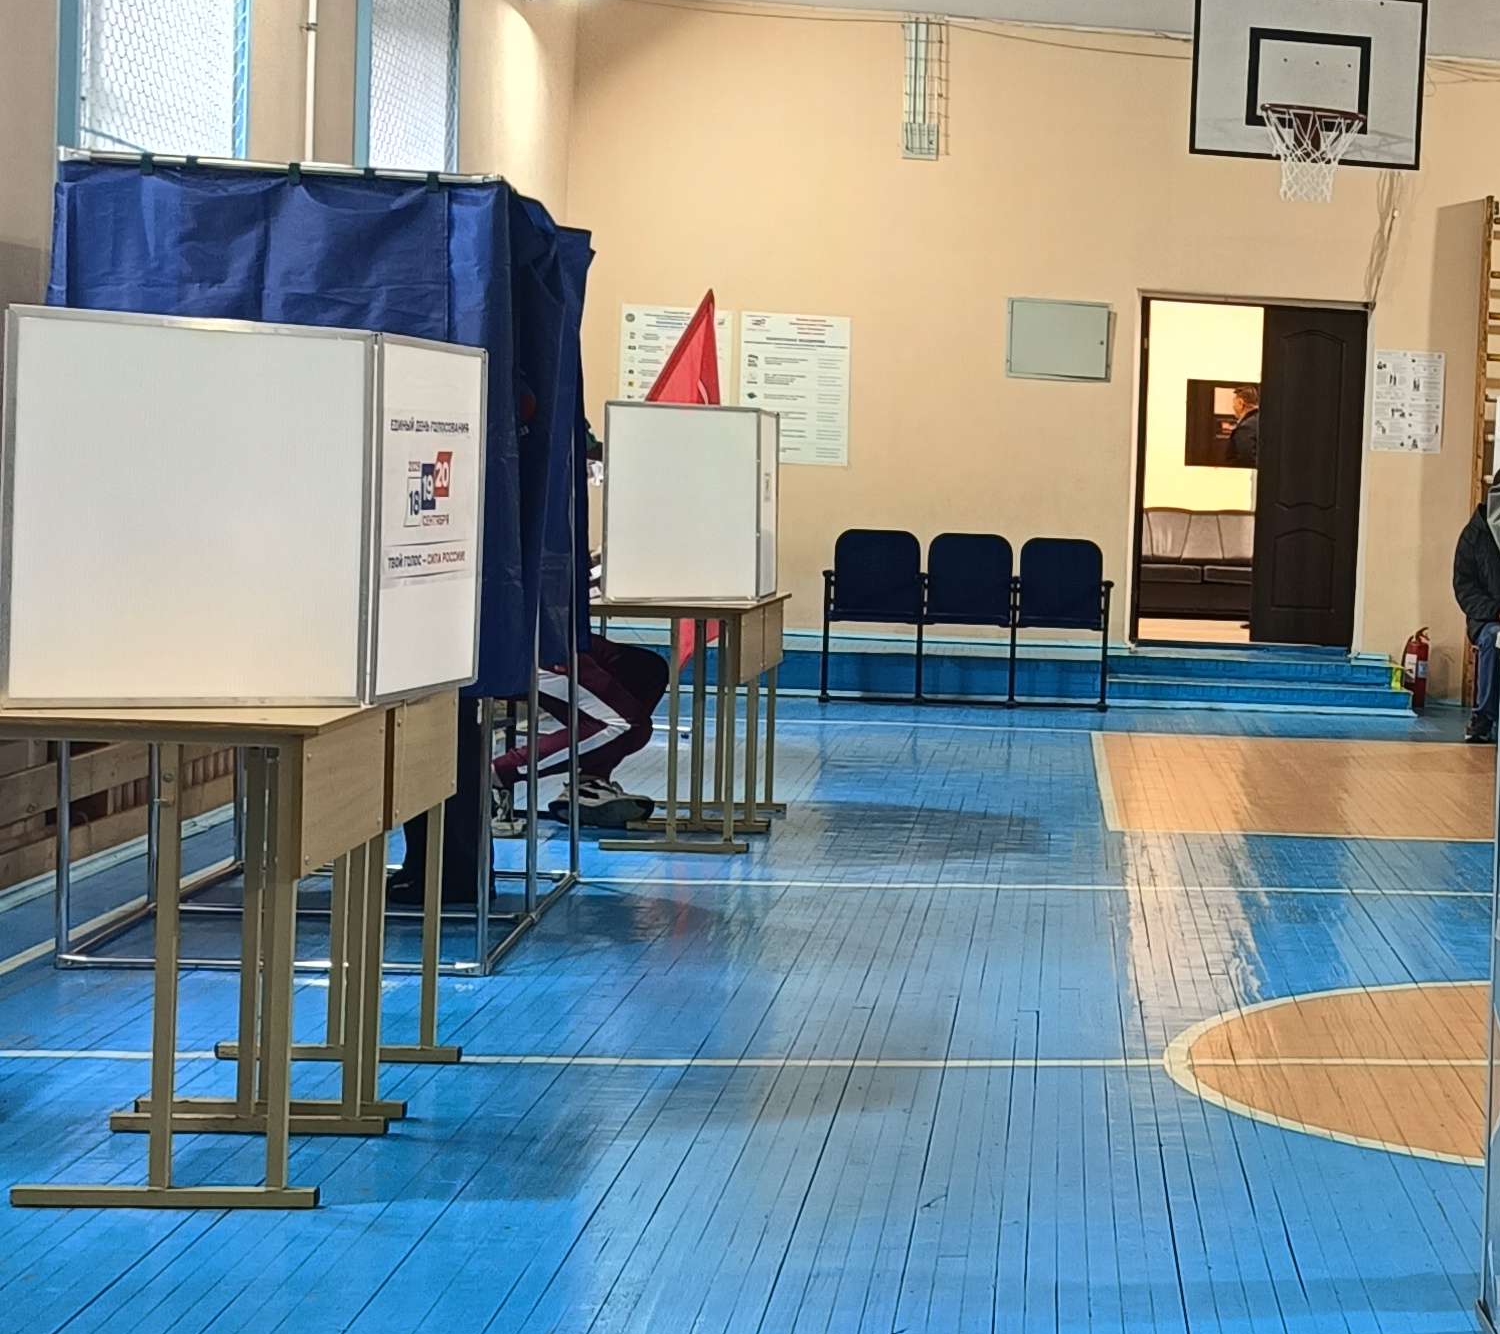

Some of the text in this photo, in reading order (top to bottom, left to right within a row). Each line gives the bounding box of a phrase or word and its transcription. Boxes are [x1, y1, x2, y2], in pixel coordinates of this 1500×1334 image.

[435, 462, 449, 487] 20
[422, 475, 434, 501] 19
[409, 490, 420, 516] 18
